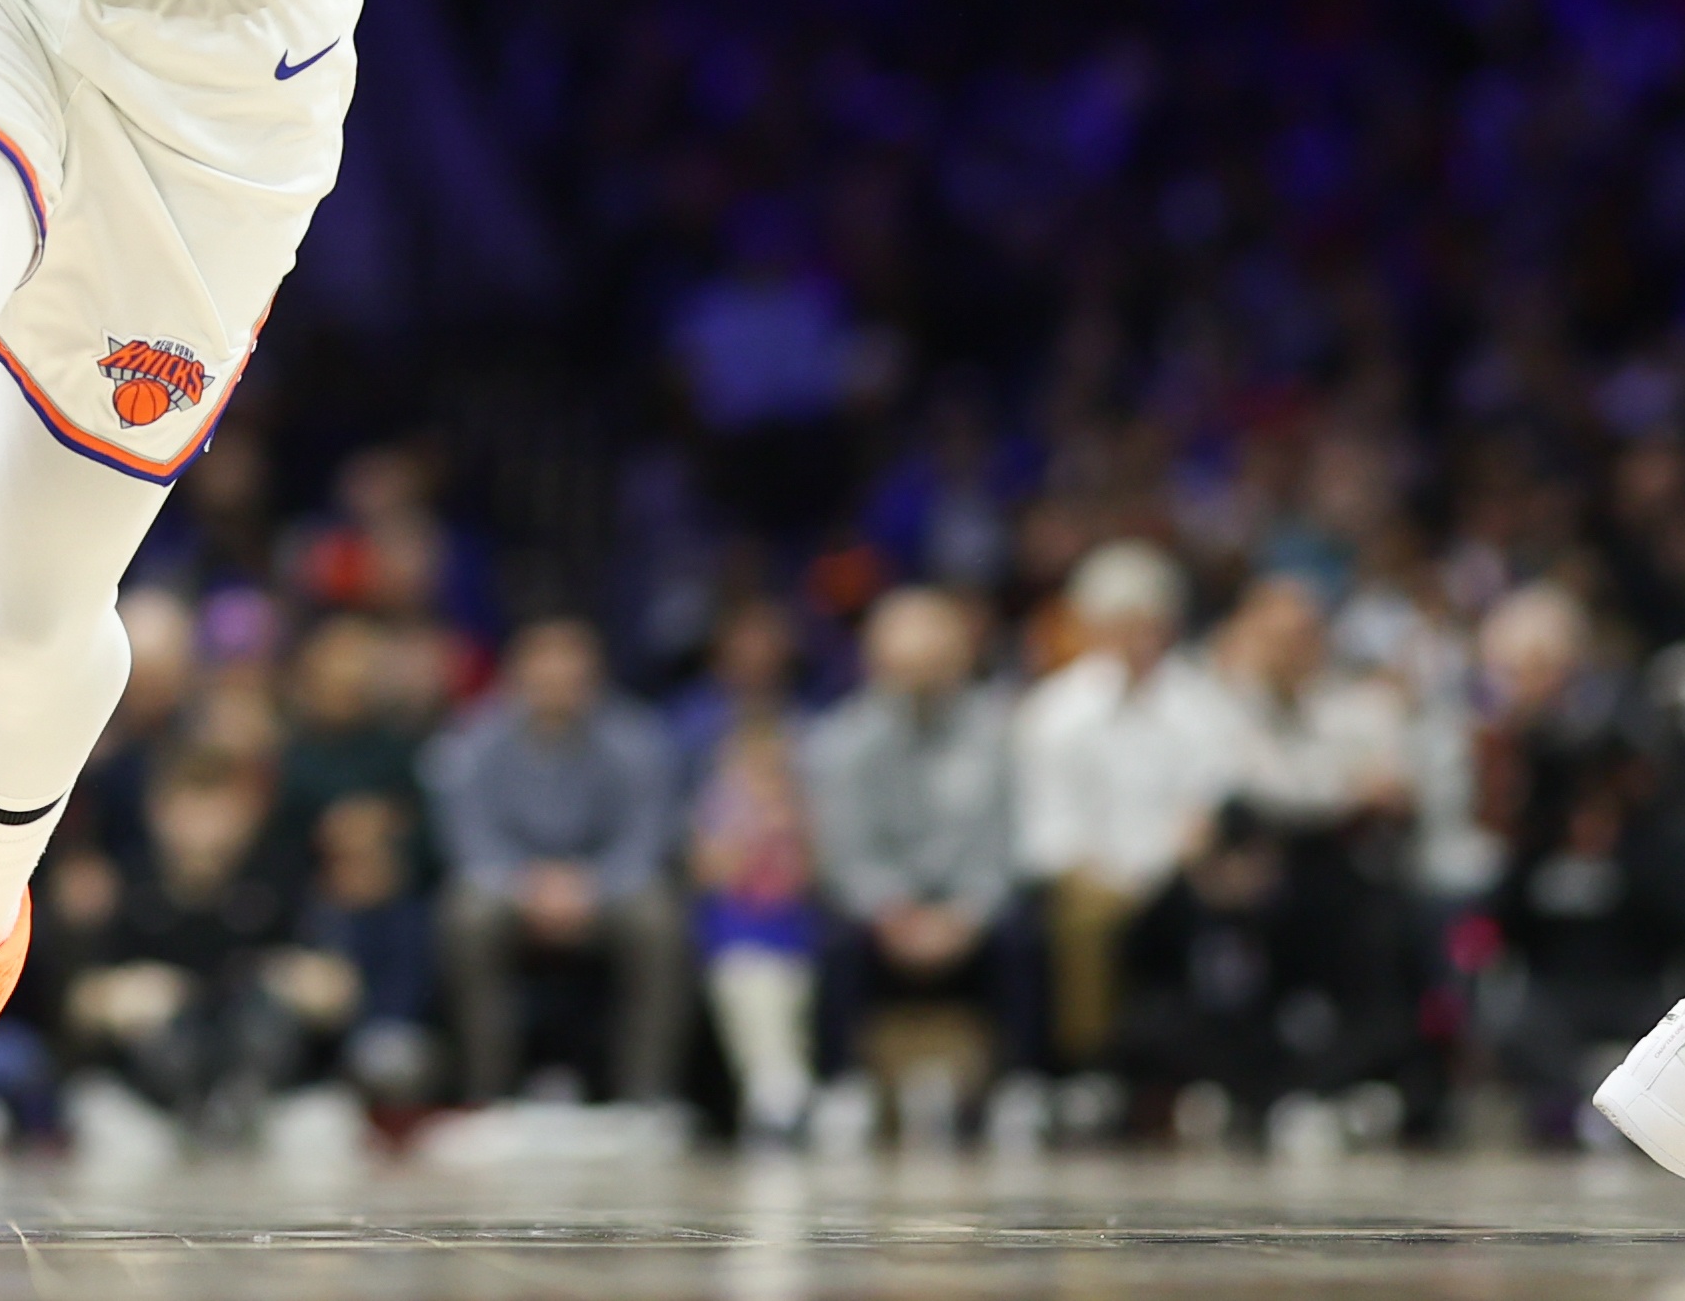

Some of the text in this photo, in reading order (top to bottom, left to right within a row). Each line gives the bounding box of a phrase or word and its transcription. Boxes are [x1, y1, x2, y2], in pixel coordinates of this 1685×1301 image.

[153, 340, 194, 360] NEW YORK
[97, 340, 204, 405] KNICKS
